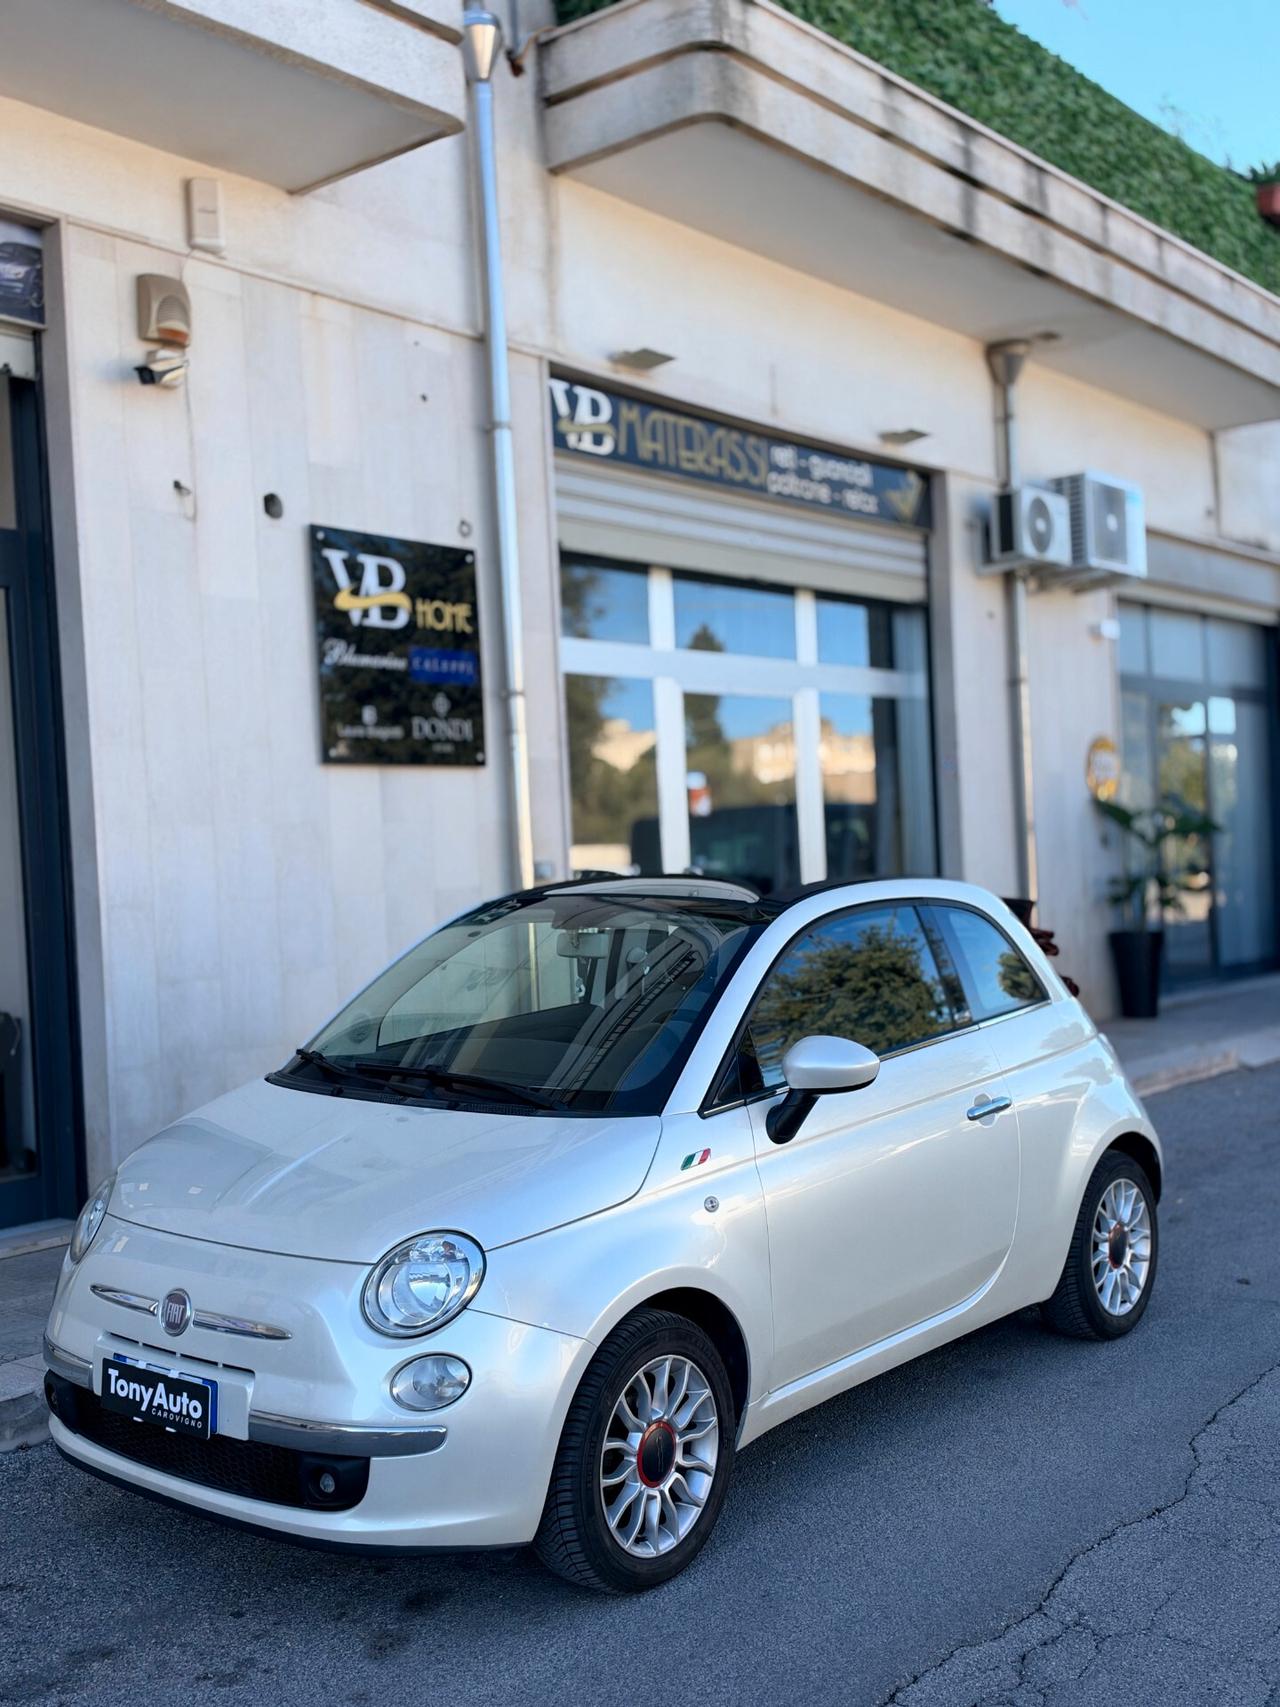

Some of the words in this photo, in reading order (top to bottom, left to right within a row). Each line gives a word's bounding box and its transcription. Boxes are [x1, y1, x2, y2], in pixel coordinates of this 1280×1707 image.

[322, 548, 411, 630] VB
[416, 598, 473, 633] HOME
[411, 716, 473, 741] DONDI
[166, 1302, 185, 1324] FIAT
[107, 1368, 202, 1419] TonyAuto
[151, 1408, 203, 1429] CAROVIGNO
